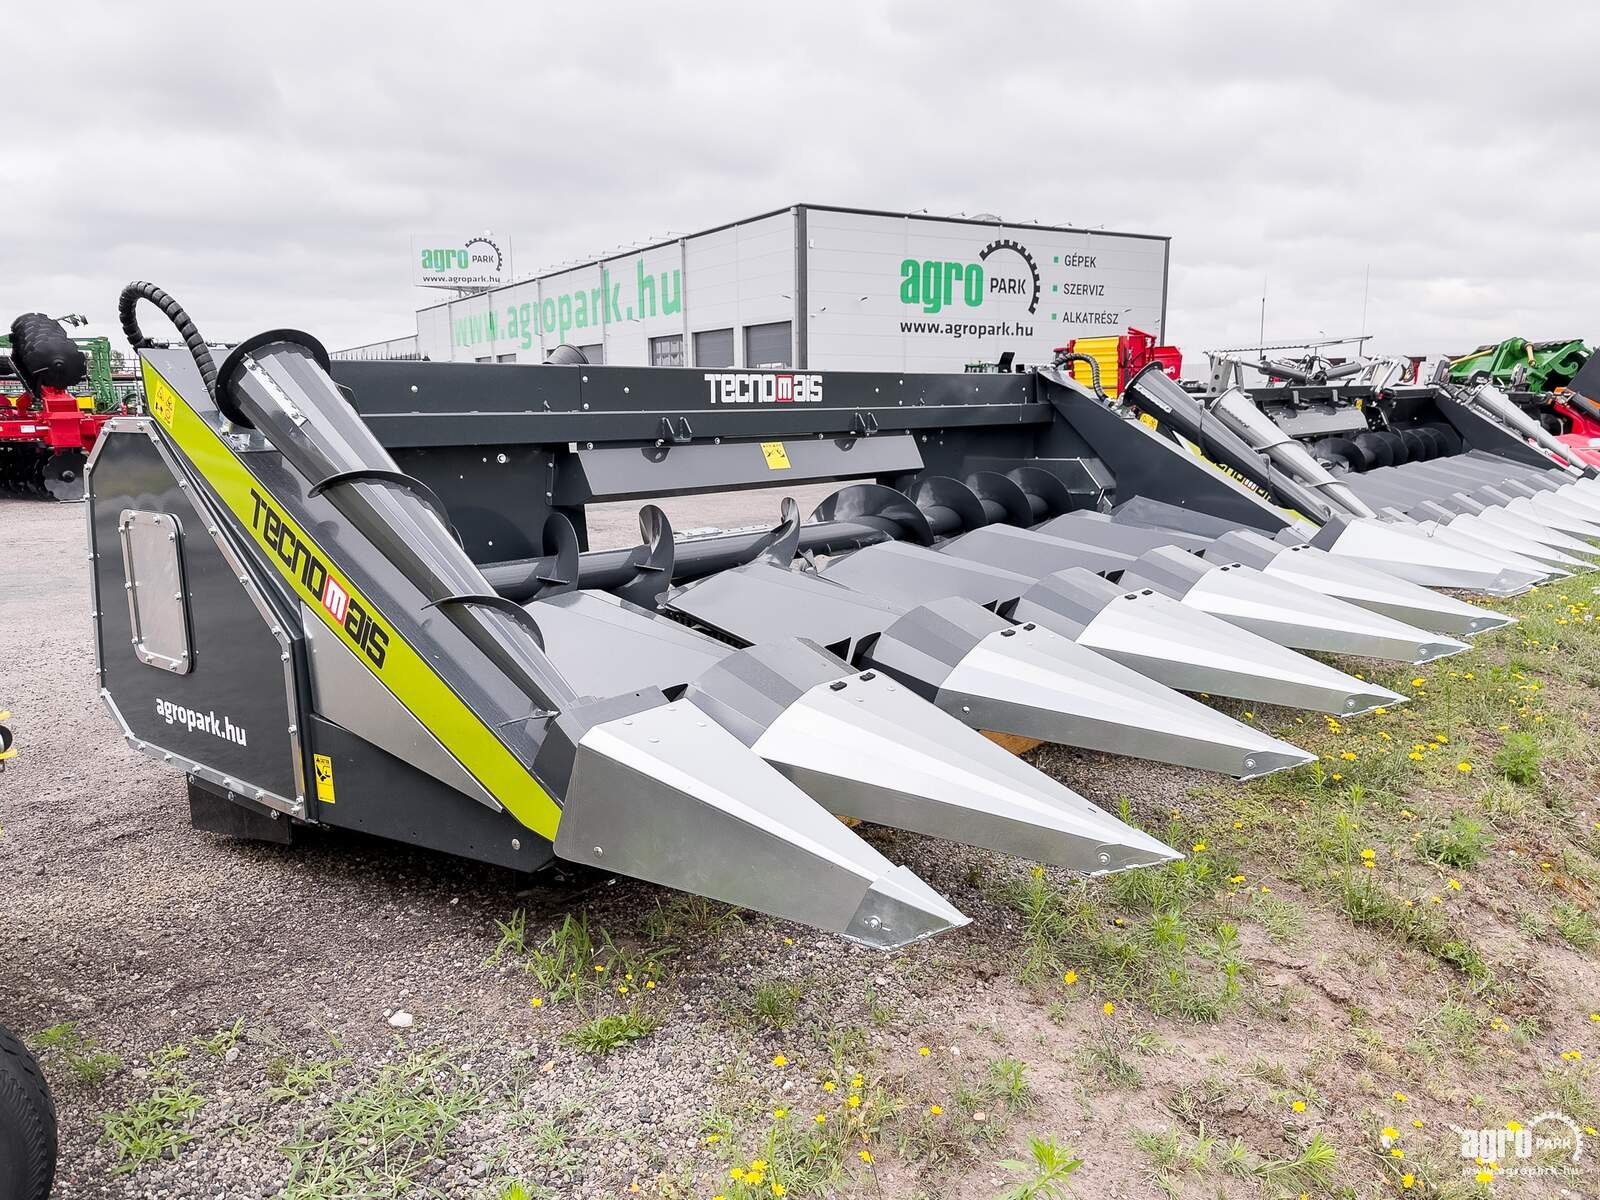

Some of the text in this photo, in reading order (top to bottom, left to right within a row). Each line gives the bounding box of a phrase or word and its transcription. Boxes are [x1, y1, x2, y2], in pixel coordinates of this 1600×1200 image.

[421, 247, 495, 273] agro PARK
[1064, 253, 1097, 269] GÉPEK
[422, 275, 501, 285] www.agropark.hu
[900, 258, 1027, 314] agro PARK
[1063, 283, 1105, 297] SZERVIZ
[454, 258, 682, 350] www.agropark.hu
[1062, 310, 1119, 325] ALKATRÉSZ
[900, 321, 1034, 339] www.agropark.hu
[156, 697, 248, 747] agropark.hu
